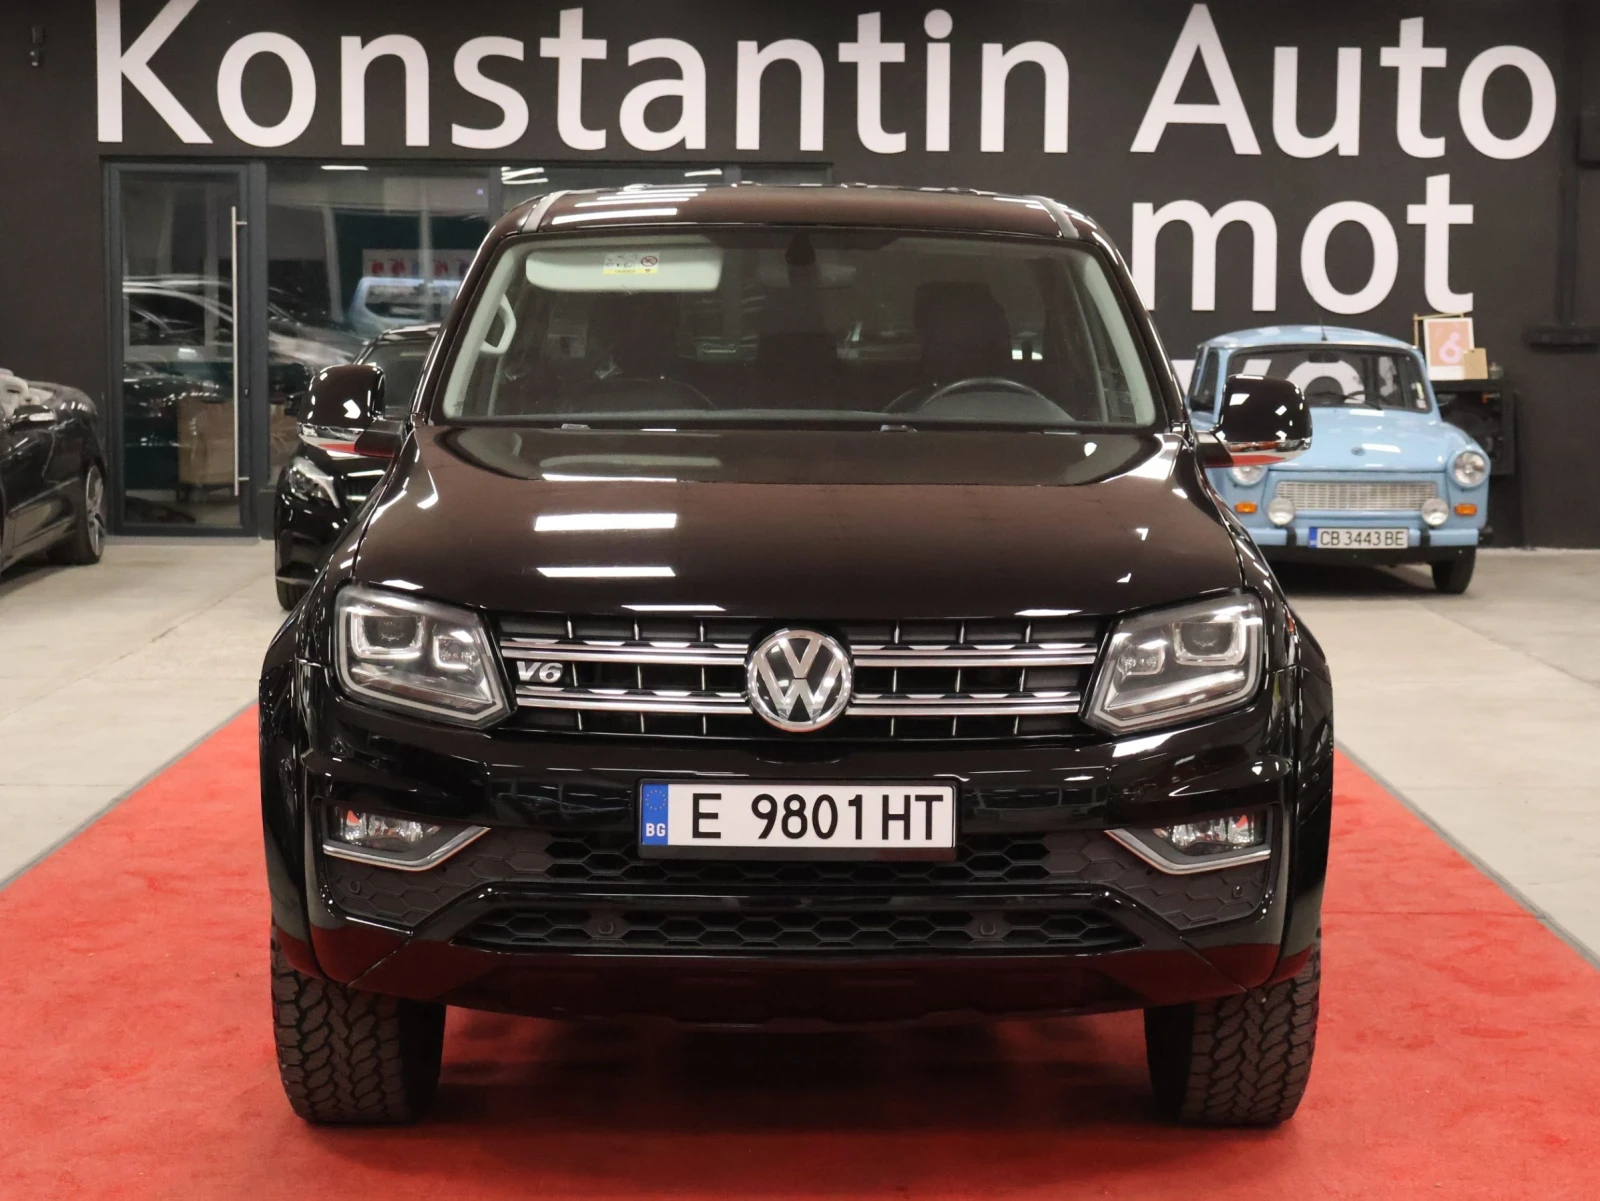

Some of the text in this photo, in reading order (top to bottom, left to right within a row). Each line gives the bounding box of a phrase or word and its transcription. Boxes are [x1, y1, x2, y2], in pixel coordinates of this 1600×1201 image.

[96, 0, 1557, 161] Konstantin Auto
[1131, 173, 1474, 315] mot
[516, 660, 563, 682] V6
[645, 822, 667, 837] BG
